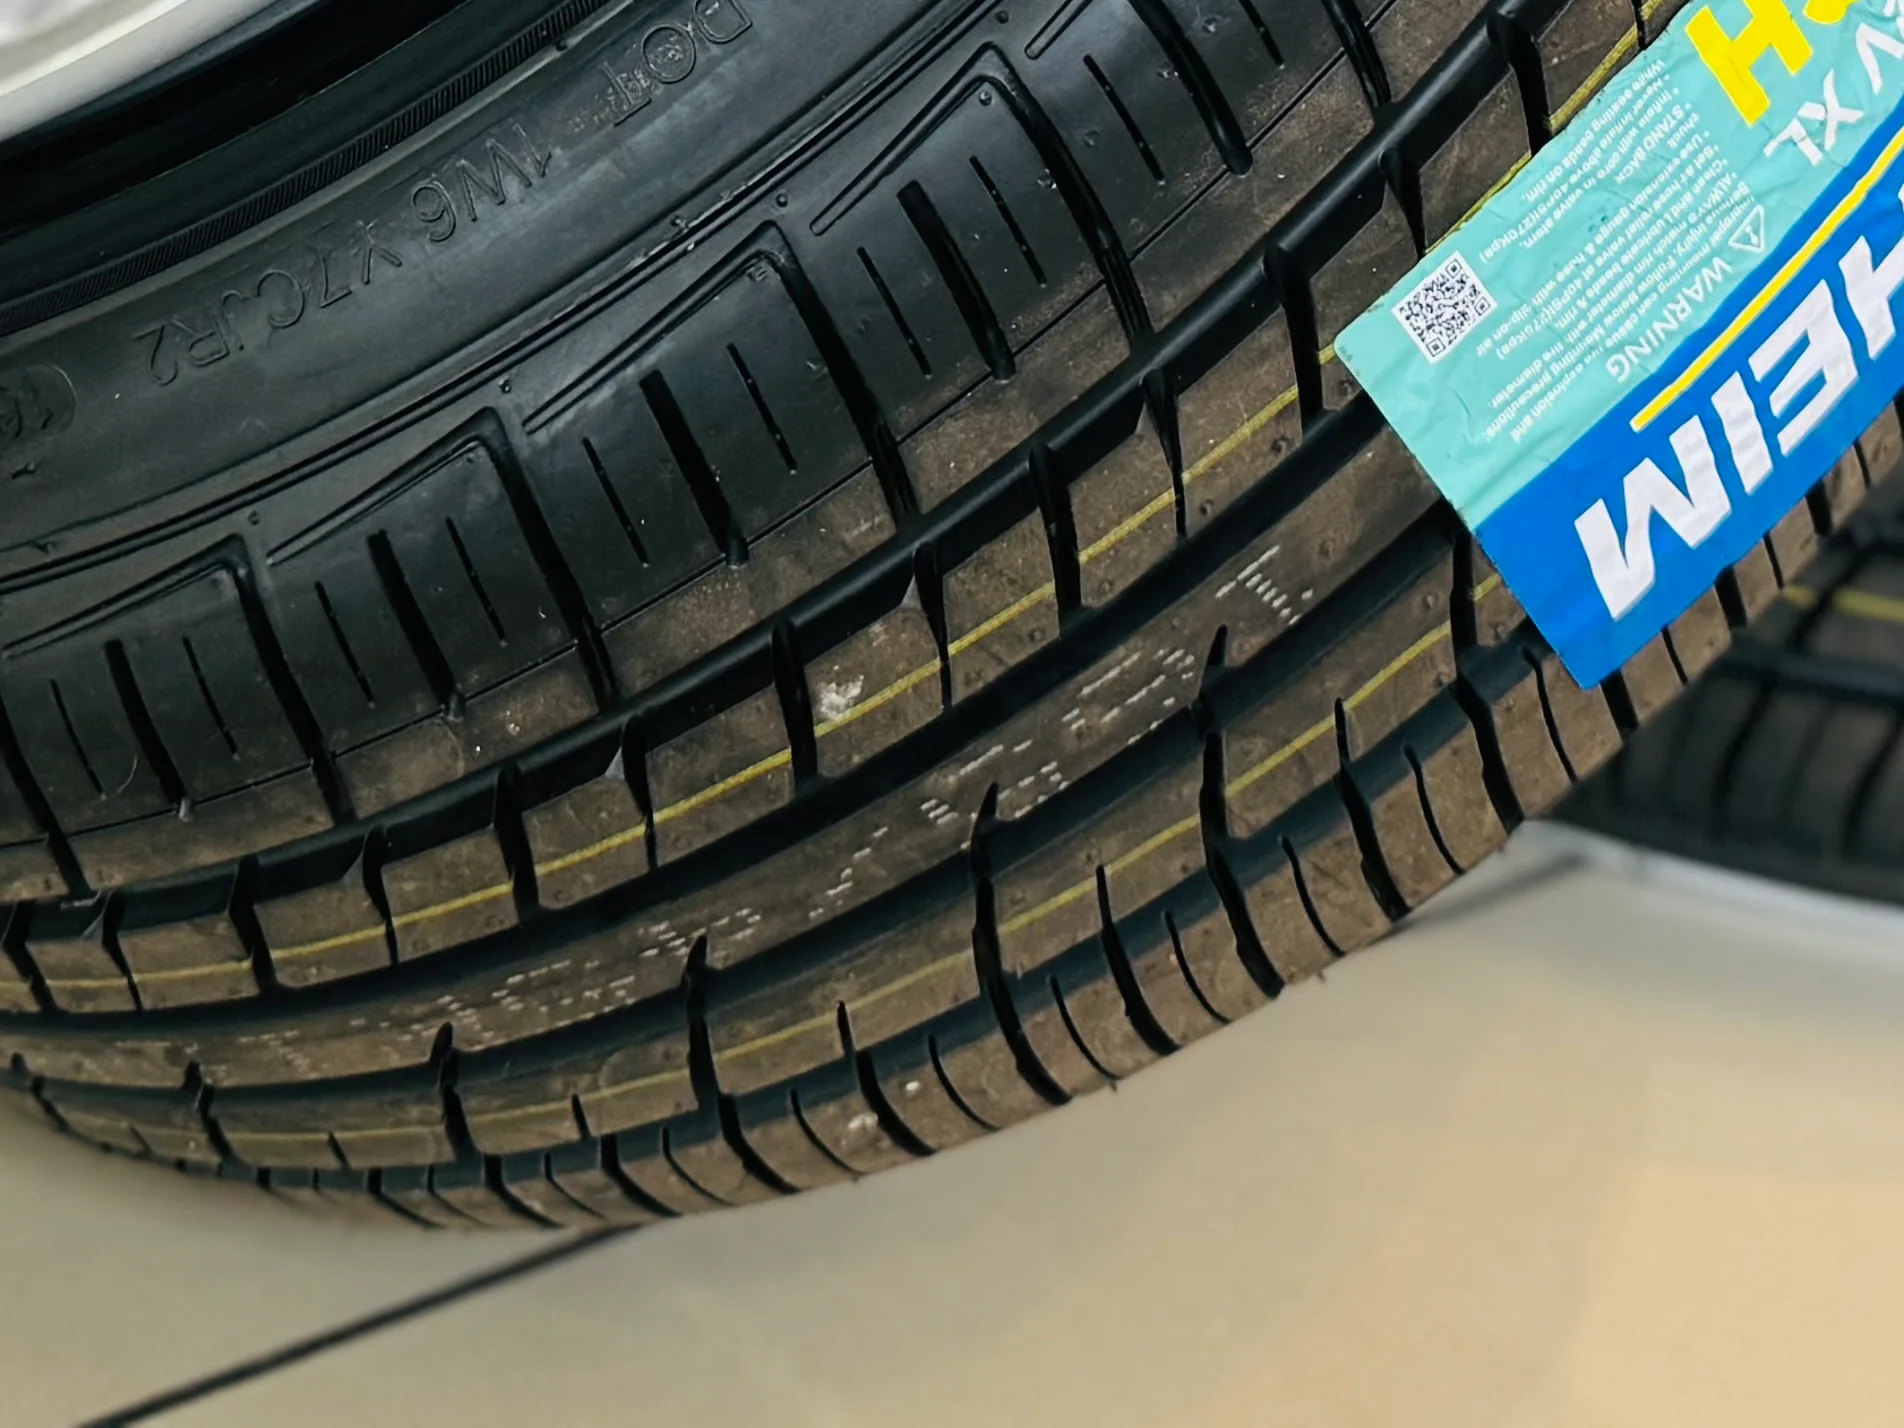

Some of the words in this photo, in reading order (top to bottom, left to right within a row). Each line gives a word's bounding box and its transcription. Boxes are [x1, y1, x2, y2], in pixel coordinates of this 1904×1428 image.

[1644, 105, 1684, 151] STAND
[1667, 113, 1699, 148] chuck
[1680, 135, 1703, 159] Use
[1764, 96, 1860, 167] XL
[411, 120, 555, 245] 1W6
[1616, 146, 1646, 183] BACK
[1692, 160, 1723, 195] Clean
[1658, 244, 1711, 293] mounting
[1588, 272, 1634, 322] diameter
[1607, 256, 1734, 384] WARNING
